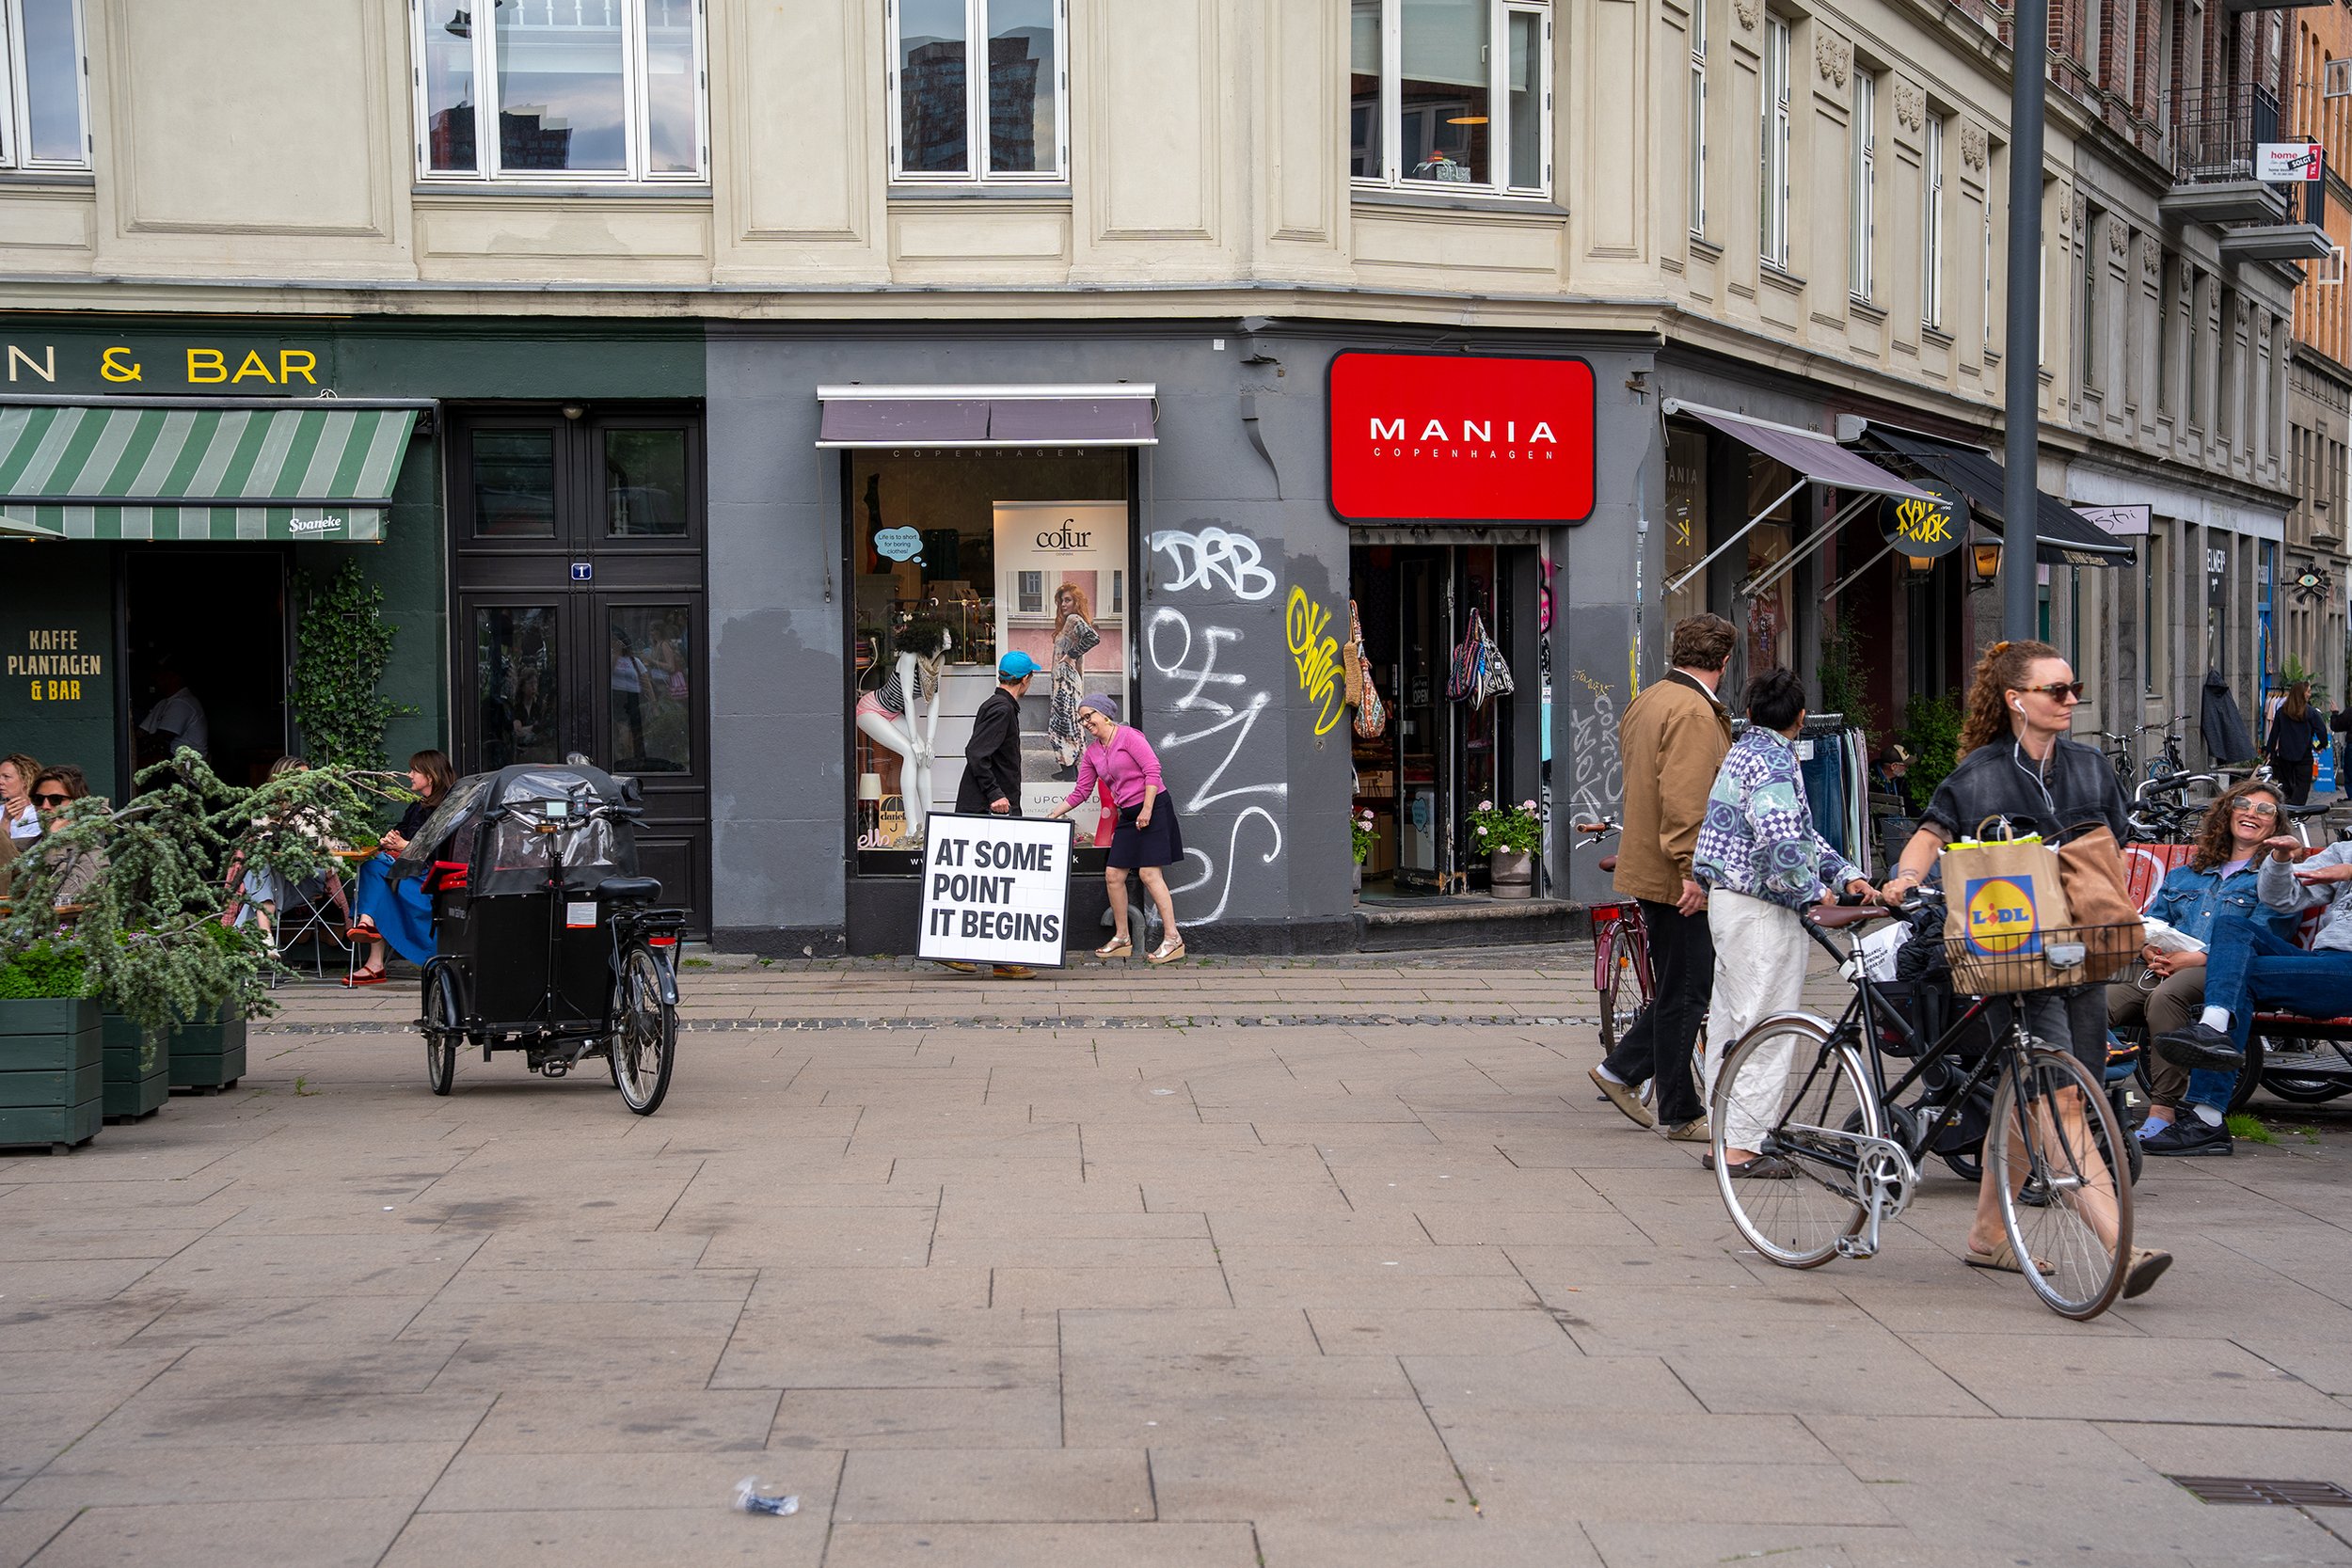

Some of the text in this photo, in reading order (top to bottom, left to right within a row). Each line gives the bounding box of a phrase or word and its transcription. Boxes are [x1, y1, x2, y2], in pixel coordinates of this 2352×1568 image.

[2270, 150, 2298, 160] home
[2291, 155, 2312, 168] SOLGT
[100, 346, 142, 383] &
[186, 348, 318, 384] BAR
[1370, 417, 1558, 444] MANIA
[893, 450, 1084, 458] COPENHAGEN
[1374, 447, 1553, 459] COPENHAGEN
[1668, 466, 1698, 484] ANIA
[289, 515, 342, 532] Svaneke
[1036, 518, 1091, 550] cofur
[579, 566, 584, 578] 1
[29, 629, 78, 650] KAFFE
[8, 655, 101, 675] PLANTAGEN
[30, 680, 81, 701] & BAR
[1034, 796, 1100, 804] UPCYED
[935, 838, 1053, 872] AT SOME
[932, 873, 1015, 905] POINT
[930, 908, 1059, 942] IT BEGINS
